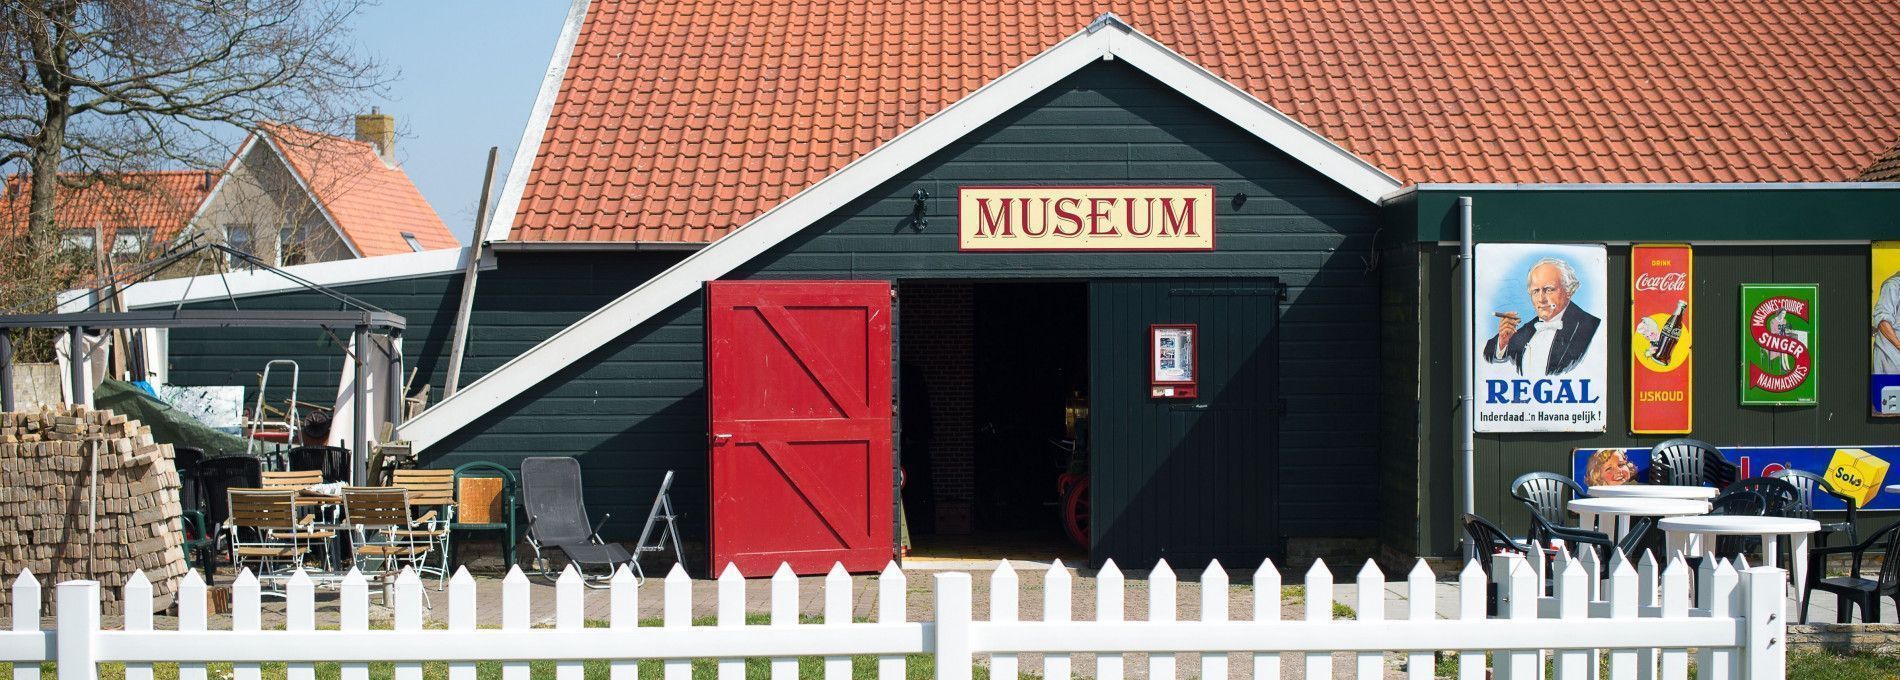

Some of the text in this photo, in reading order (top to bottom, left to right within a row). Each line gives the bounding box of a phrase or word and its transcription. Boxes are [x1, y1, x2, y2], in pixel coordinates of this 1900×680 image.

[973, 197, 1201, 238] MUSEUM
[1635, 272, 1687, 292] Coca-Cola
[1752, 299, 1779, 327] MACHINES
[1758, 332, 1804, 359] SINGER
[1756, 364, 1808, 391] NAAIMACHINES
[1485, 378, 1600, 405] REGAL
[1639, 391, 1684, 402] IJSKOUD
[1538, 411, 1570, 422] Havana
[1572, 410, 1596, 424] gelijk
